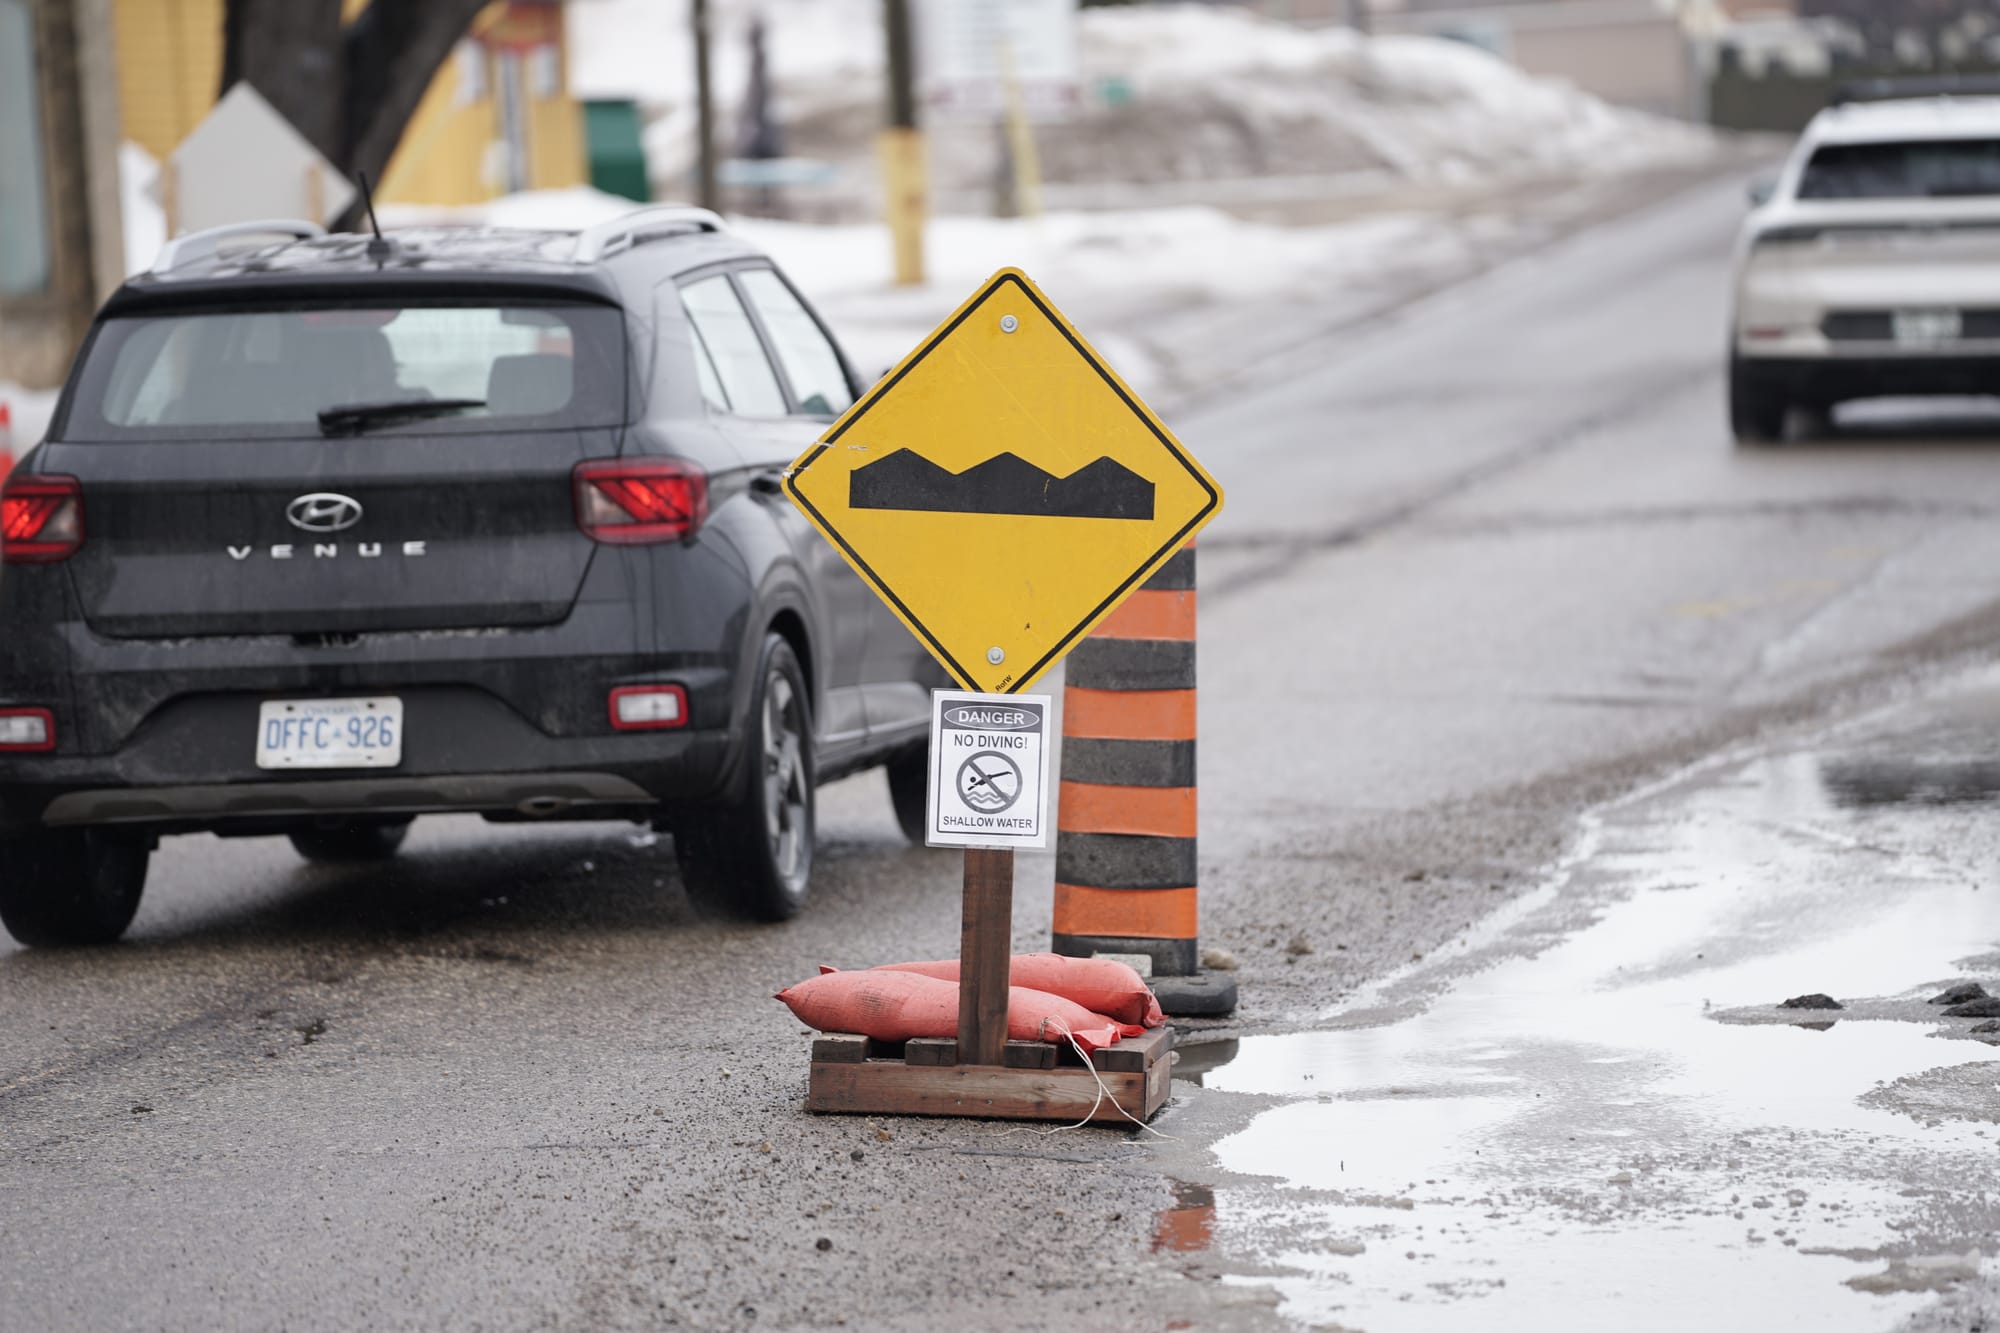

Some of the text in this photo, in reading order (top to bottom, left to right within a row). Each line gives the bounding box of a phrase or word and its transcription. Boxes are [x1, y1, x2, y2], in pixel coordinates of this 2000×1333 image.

[227, 541, 427, 560] VENUE
[958, 710, 1025, 725] DANGER
[265, 714, 394, 750] DFFC 926
[954, 734, 1029, 749] NO DIVING!
[943, 815, 1033, 829] SHALLOW WATER
